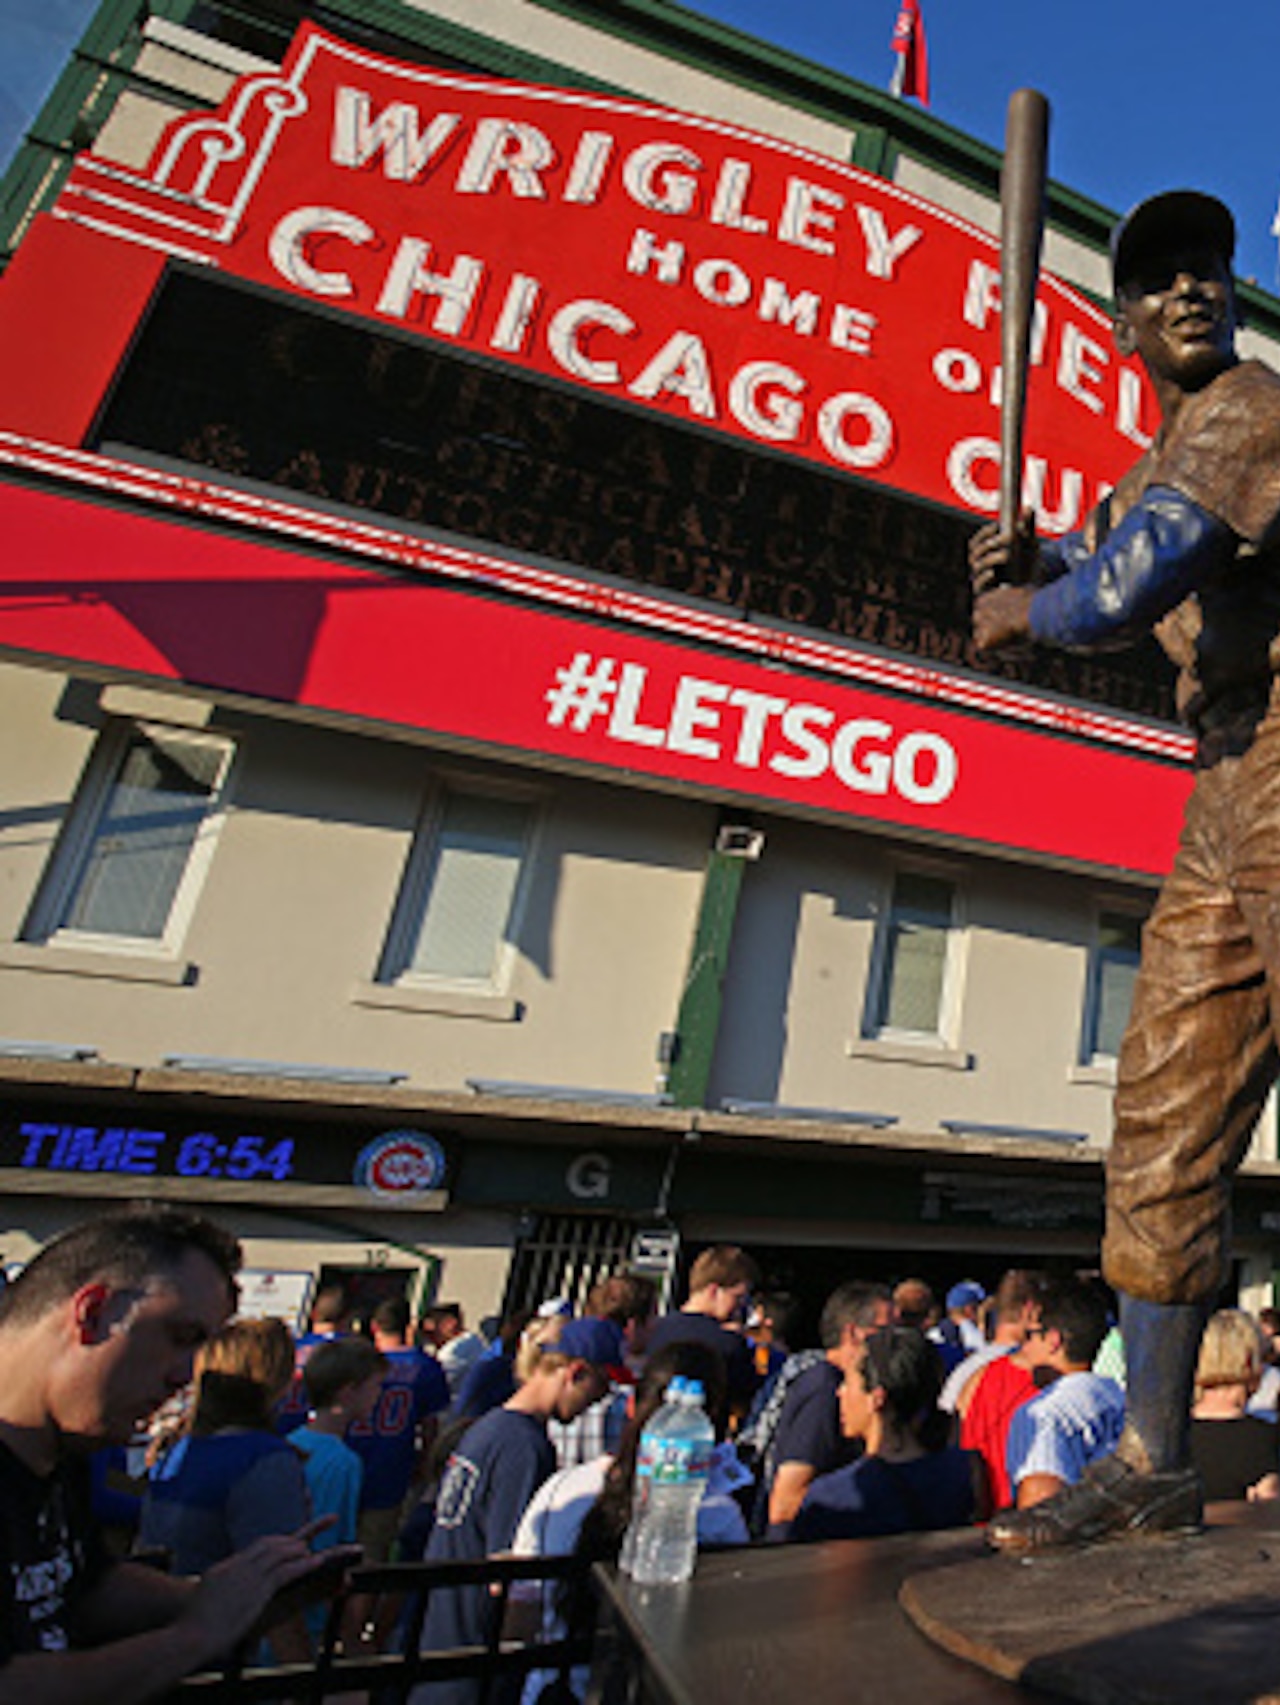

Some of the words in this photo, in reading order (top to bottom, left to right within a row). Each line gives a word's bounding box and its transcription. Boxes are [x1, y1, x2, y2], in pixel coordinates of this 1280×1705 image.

[331, 86, 921, 280] WRIGLEY
[963, 259, 1155, 449] FIEL
[626, 229, 877, 354] HOME
[267, 206, 893, 467] CHICAGO
[946, 436, 1114, 533] CU
[545, 653, 959, 804] #LETSGO
[19, 1122, 166, 1173] TIME
[174, 1132, 295, 1181] 6:54
[565, 1153, 612, 1198] G
